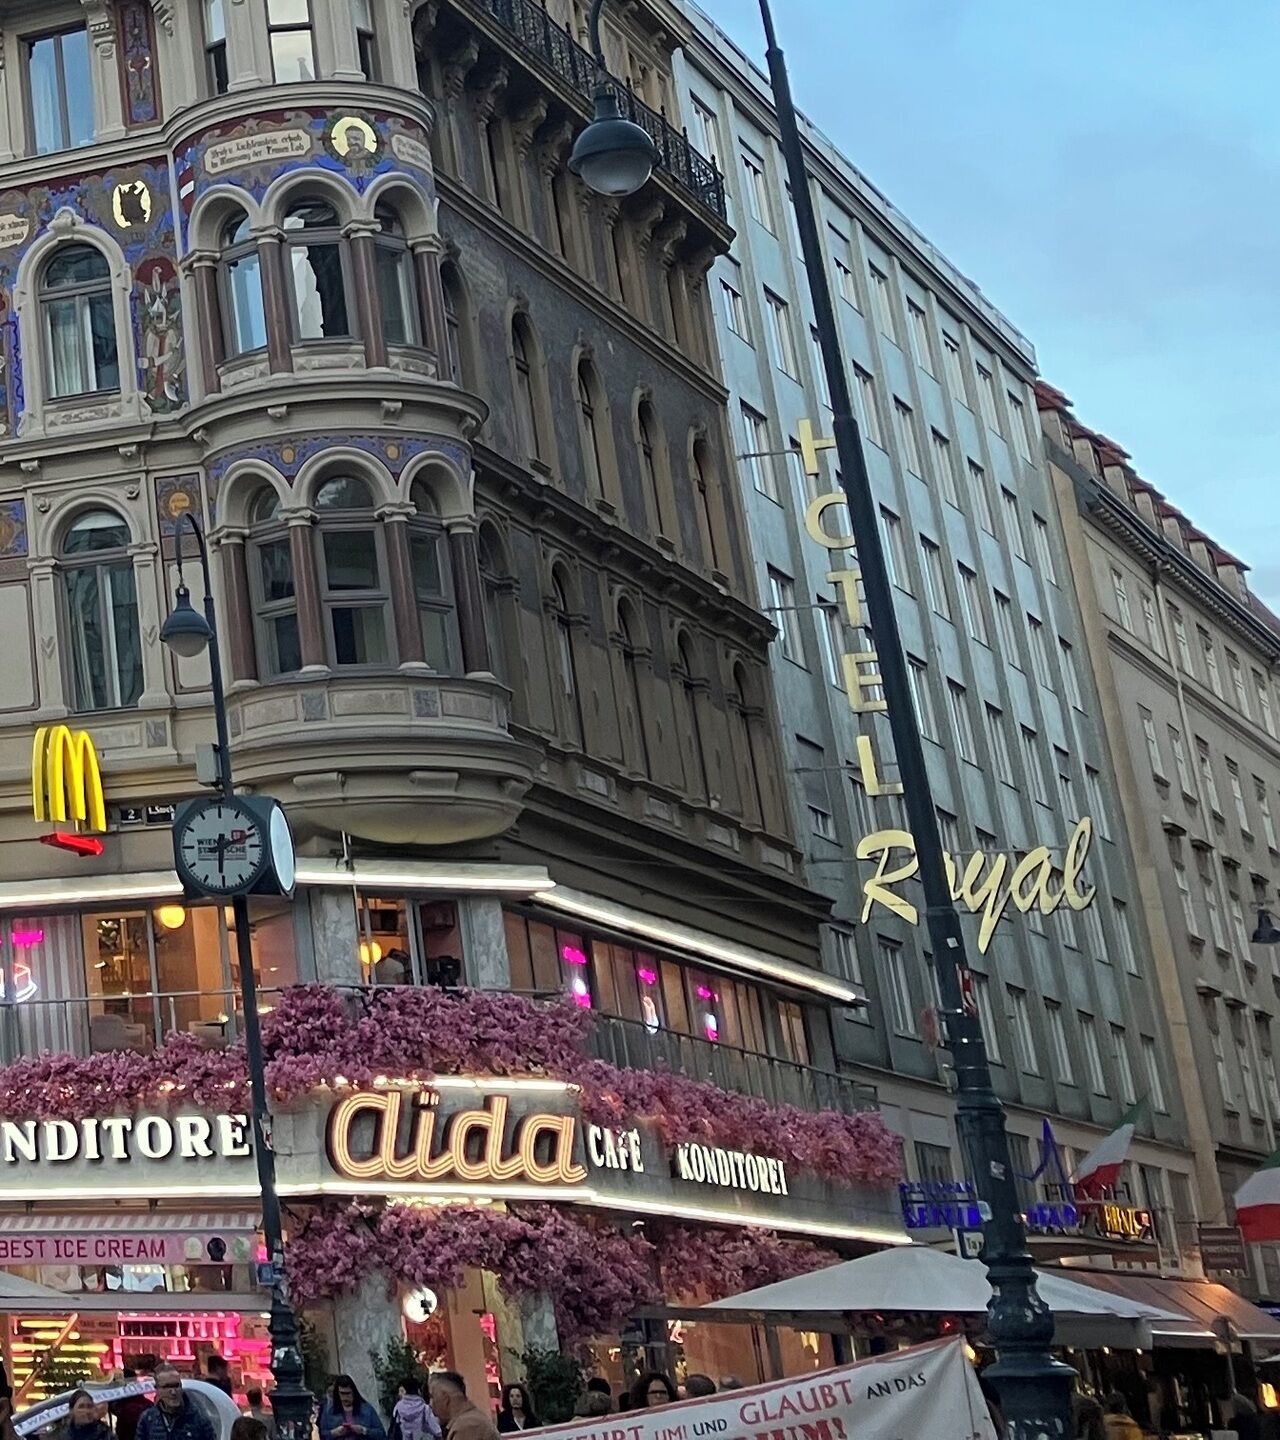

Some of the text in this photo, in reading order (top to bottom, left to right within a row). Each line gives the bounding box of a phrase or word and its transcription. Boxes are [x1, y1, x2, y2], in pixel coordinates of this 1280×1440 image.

[798, 419, 904, 797] HOTEL
[127, 808, 136, 820] 2
[856, 816, 1096, 955] Ryal
[677, 1142, 789, 1196] KONDITOREI
[54, 1239, 88, 1258] ICE
[94, 1239, 166, 1258] CREAM
[693, 1418, 727, 1436] UND
[739, 1379, 856, 1425] GLAUBT
[866, 1382, 891, 1400] AN
[895, 1372, 926, 1393] DAS
